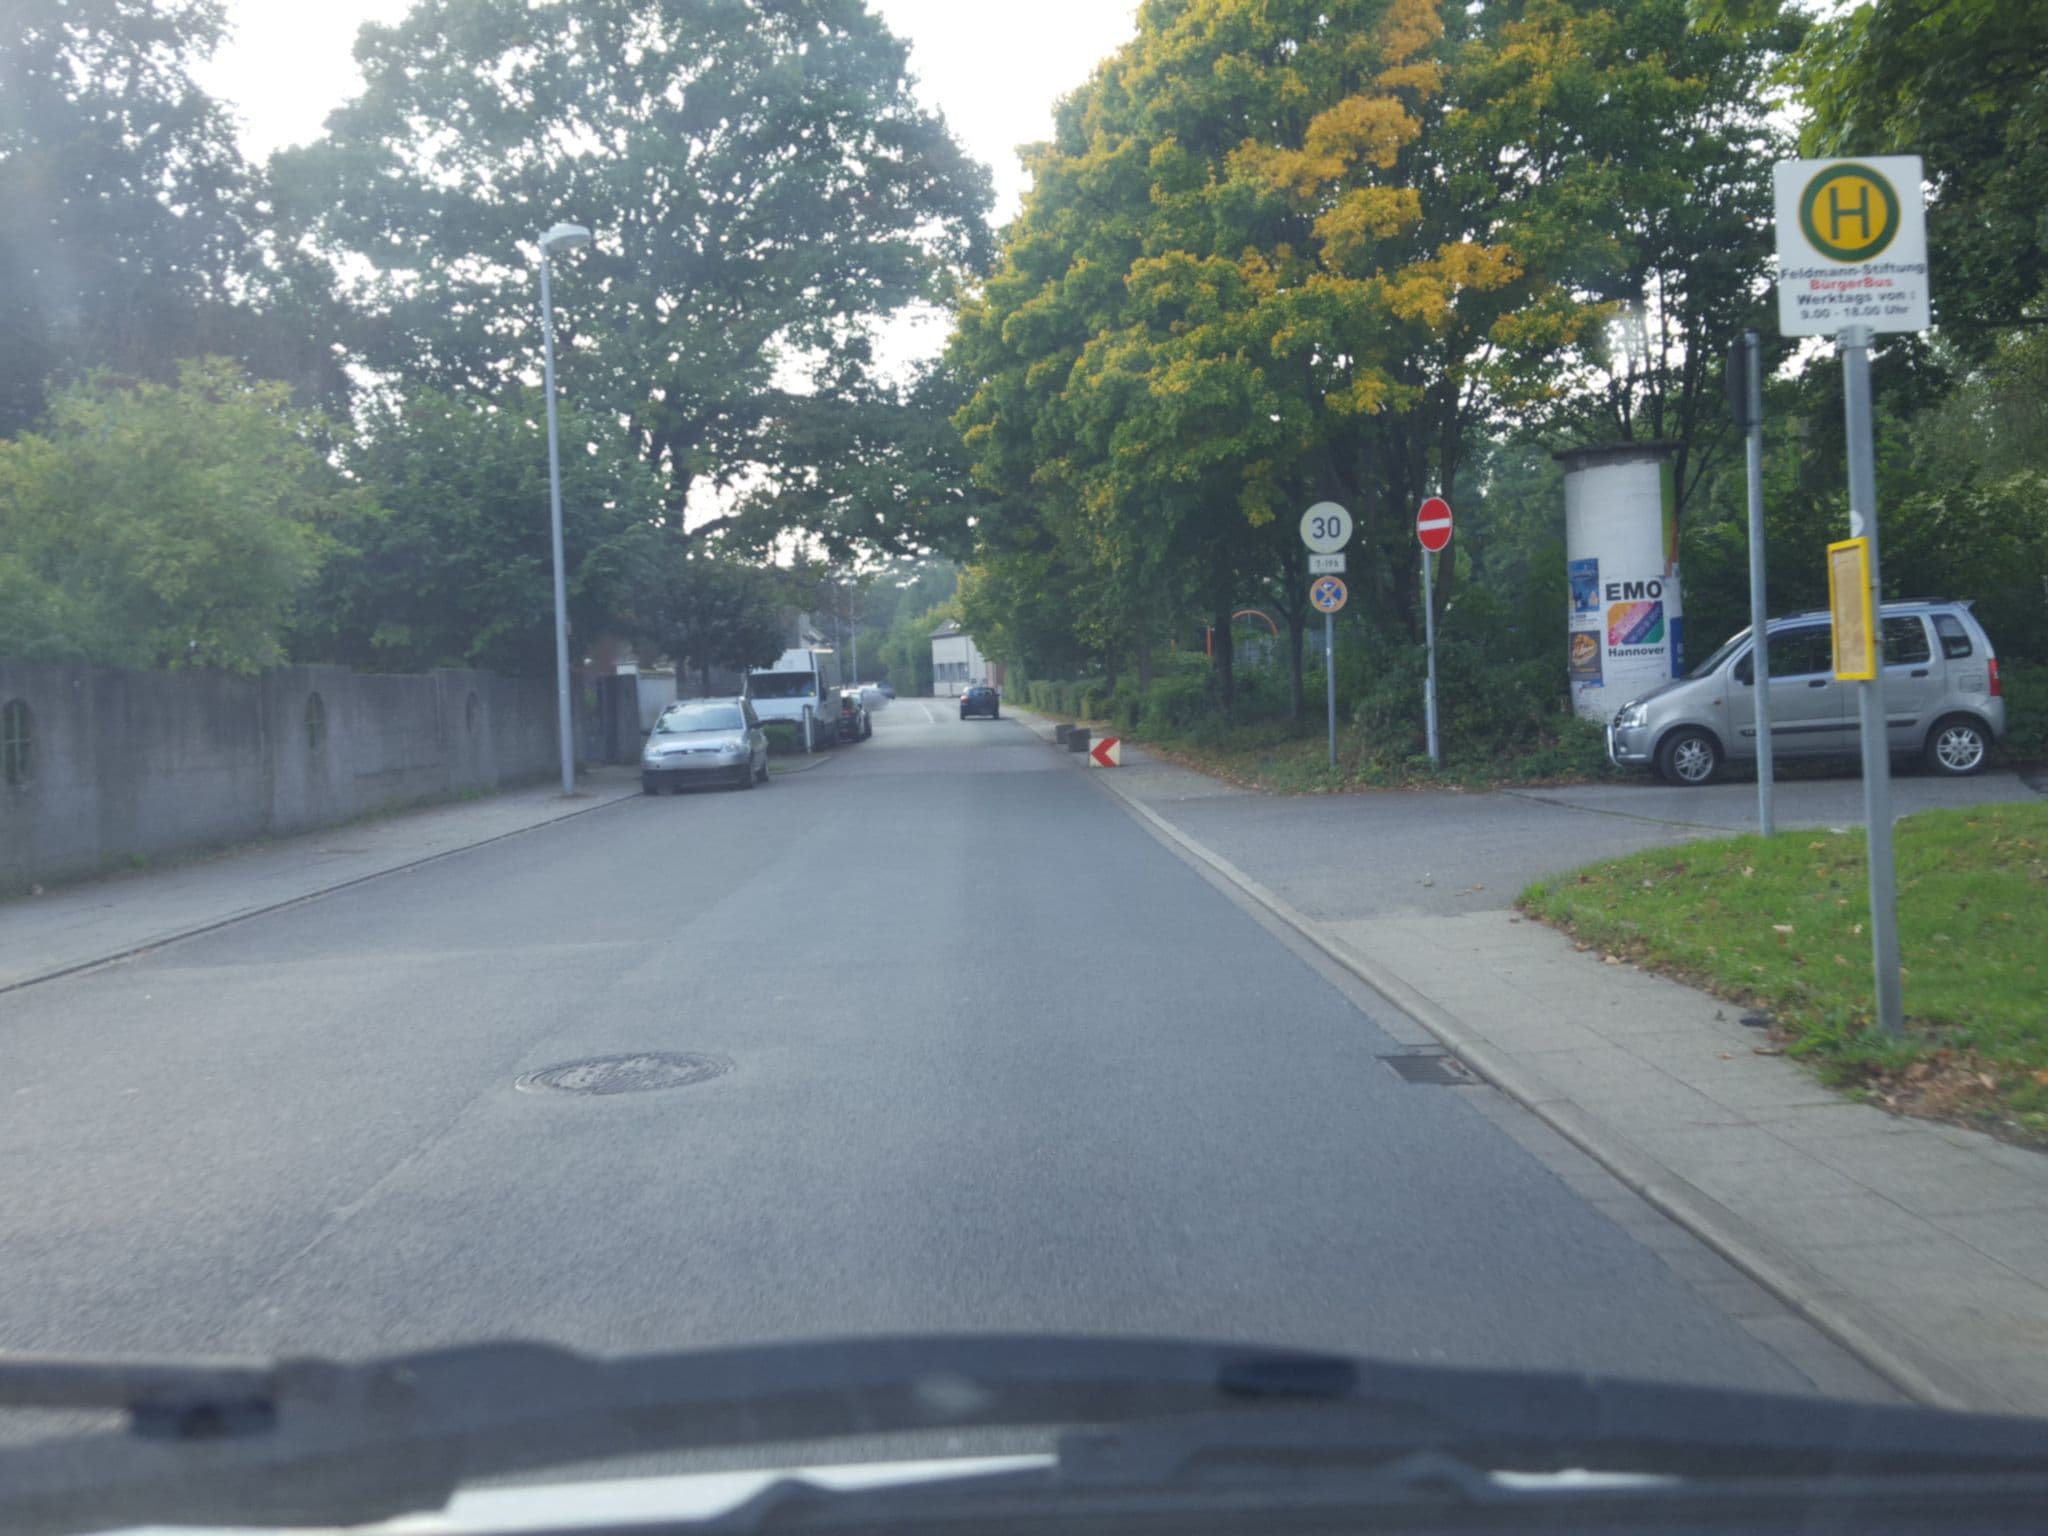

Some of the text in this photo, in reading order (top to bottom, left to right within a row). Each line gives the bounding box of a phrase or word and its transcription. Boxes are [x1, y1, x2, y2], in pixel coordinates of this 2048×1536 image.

[1829, 186, 1870, 239] H
[1797, 294, 1872, 305] Werktags
[1801, 308, 1830, 319] 9.00
[1844, 306, 1880, 317] 18.00
[1312, 516, 1341, 539] 30
[1606, 581, 1662, 600] EMO
[1608, 647, 1665, 657] Hannover
